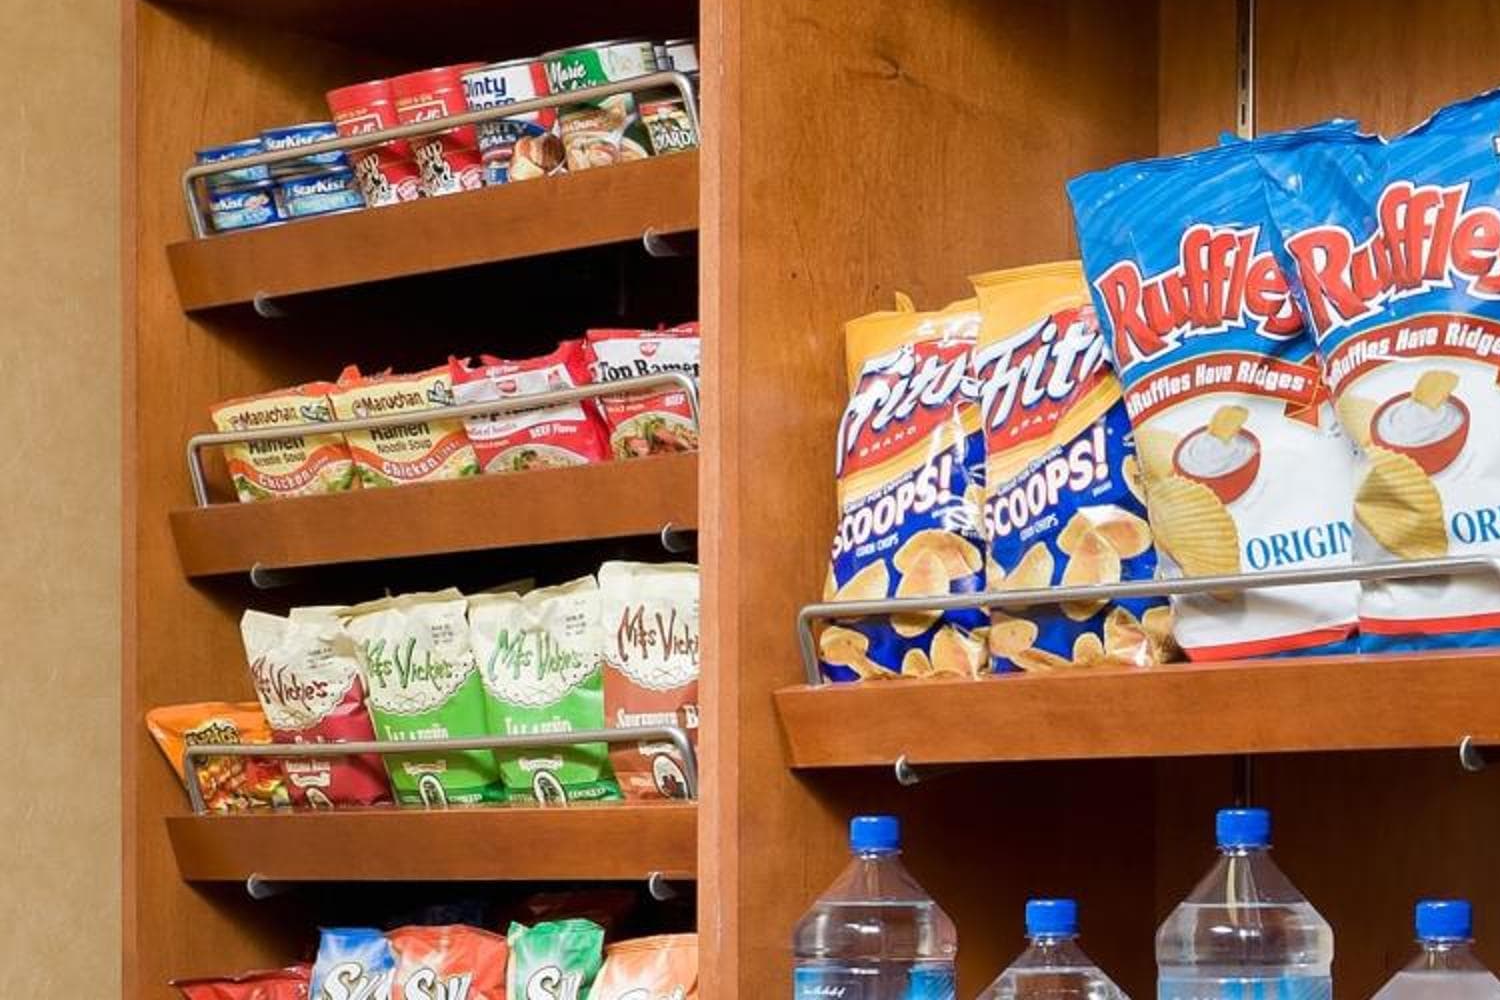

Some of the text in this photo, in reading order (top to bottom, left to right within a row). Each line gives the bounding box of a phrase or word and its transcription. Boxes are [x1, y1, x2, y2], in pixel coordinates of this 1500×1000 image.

[266, 134, 316, 151] StarKist
[293, 179, 347, 195] StarKist
[1095, 225, 1305, 368] Ruffles
[1396, 326, 1439, 352] Have
[361, 391, 424, 411] Maruchan
[1126, 360, 1304, 420] Ruffles Have Ridges
[239, 407, 299, 426] Maruchan
[383, 456, 436, 478] Chicken
[983, 425, 1109, 541] SCOOPS!
[832, 453, 952, 558] SCOOPS!
[270, 664, 328, 711] Vickie's
